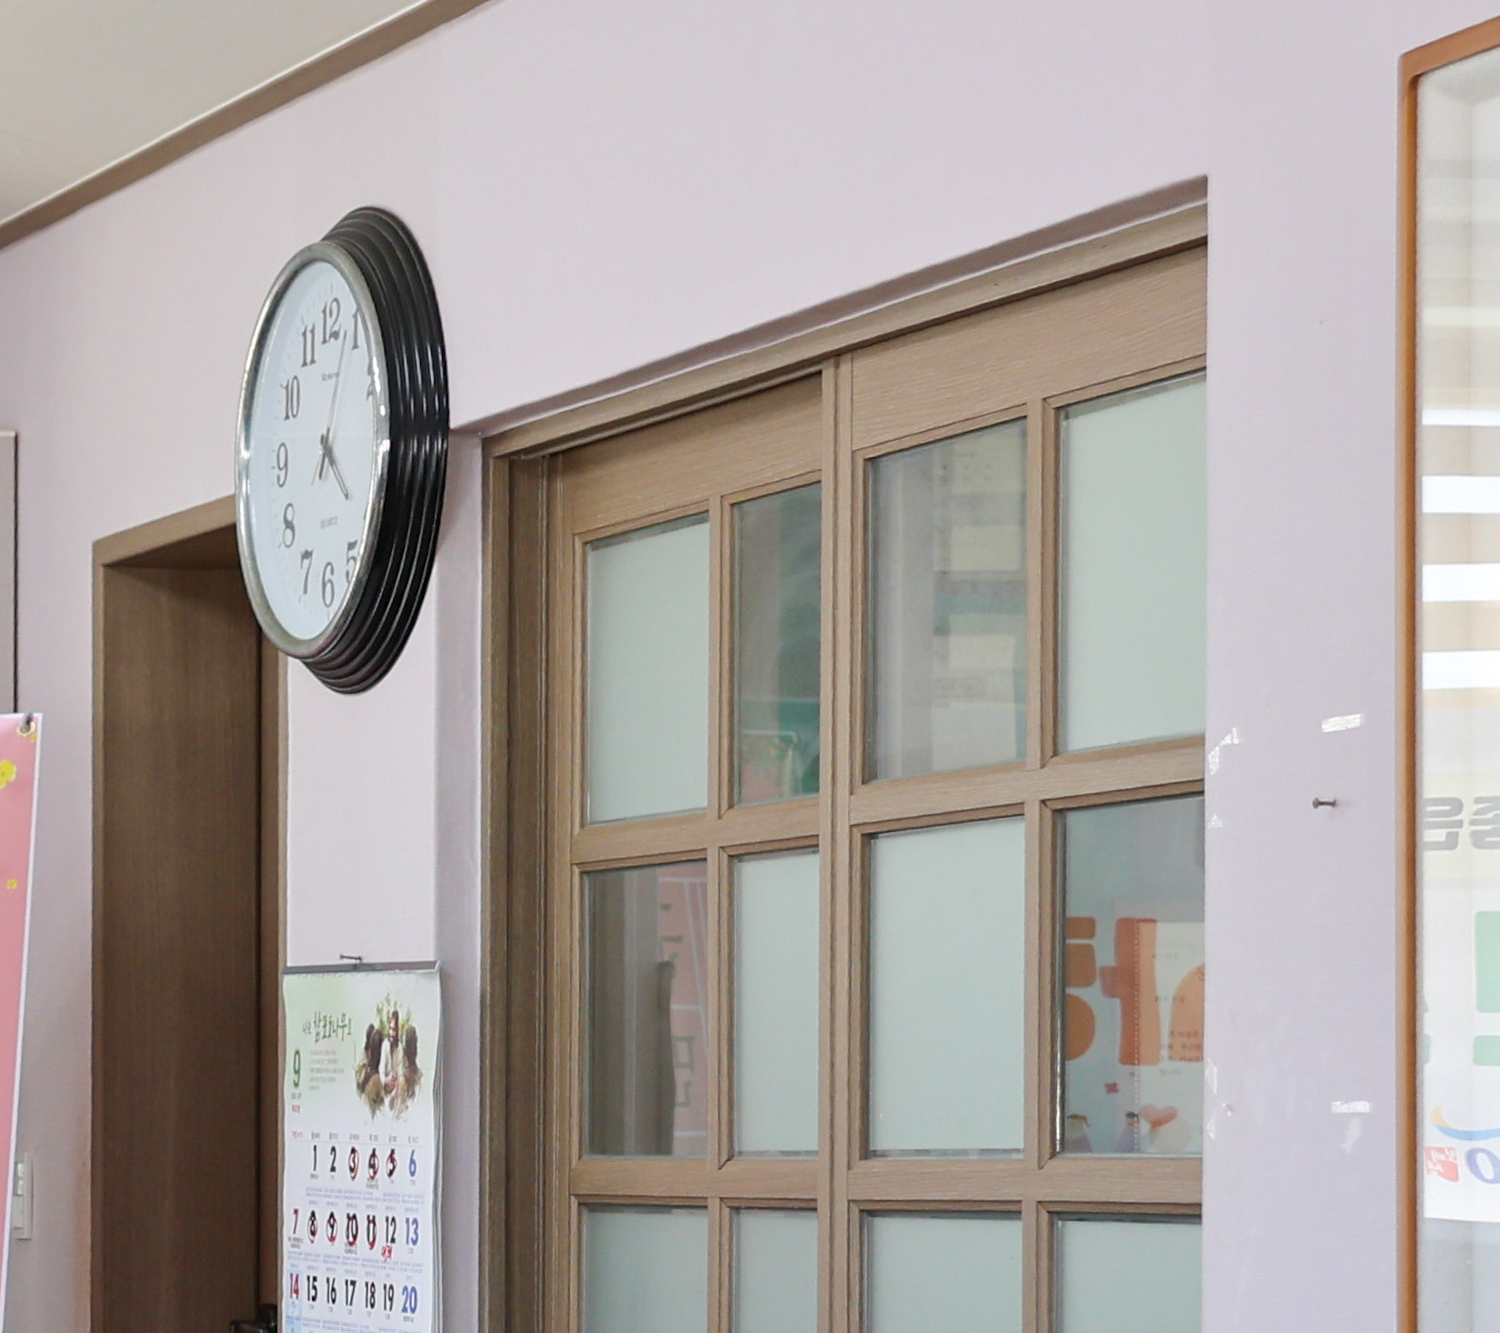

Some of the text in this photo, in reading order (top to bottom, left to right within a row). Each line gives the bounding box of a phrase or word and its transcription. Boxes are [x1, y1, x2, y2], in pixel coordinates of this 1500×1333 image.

[321, 297, 341, 345] 12
[351, 304, 359, 350] 1
[301, 322, 316, 368] 11
[284, 375, 301, 421] 10
[276, 442, 289, 488] 9
[282, 503, 296, 549] 8
[300, 548, 314, 595] 7
[321, 561, 335, 608] 6
[345, 538, 359, 585] 5
[292, 1049, 301, 1088] 9
[312, 1144, 318, 1172] 1
[329, 1145, 337, 1173] 2
[408, 1149, 417, 1178] 6
[293, 1208, 299, 1235] 7
[385, 1215, 397, 1245] 12
[405, 1216, 419, 1246] 13
[289, 1272, 418, 1315] 14 15 16 17 18 19 20
